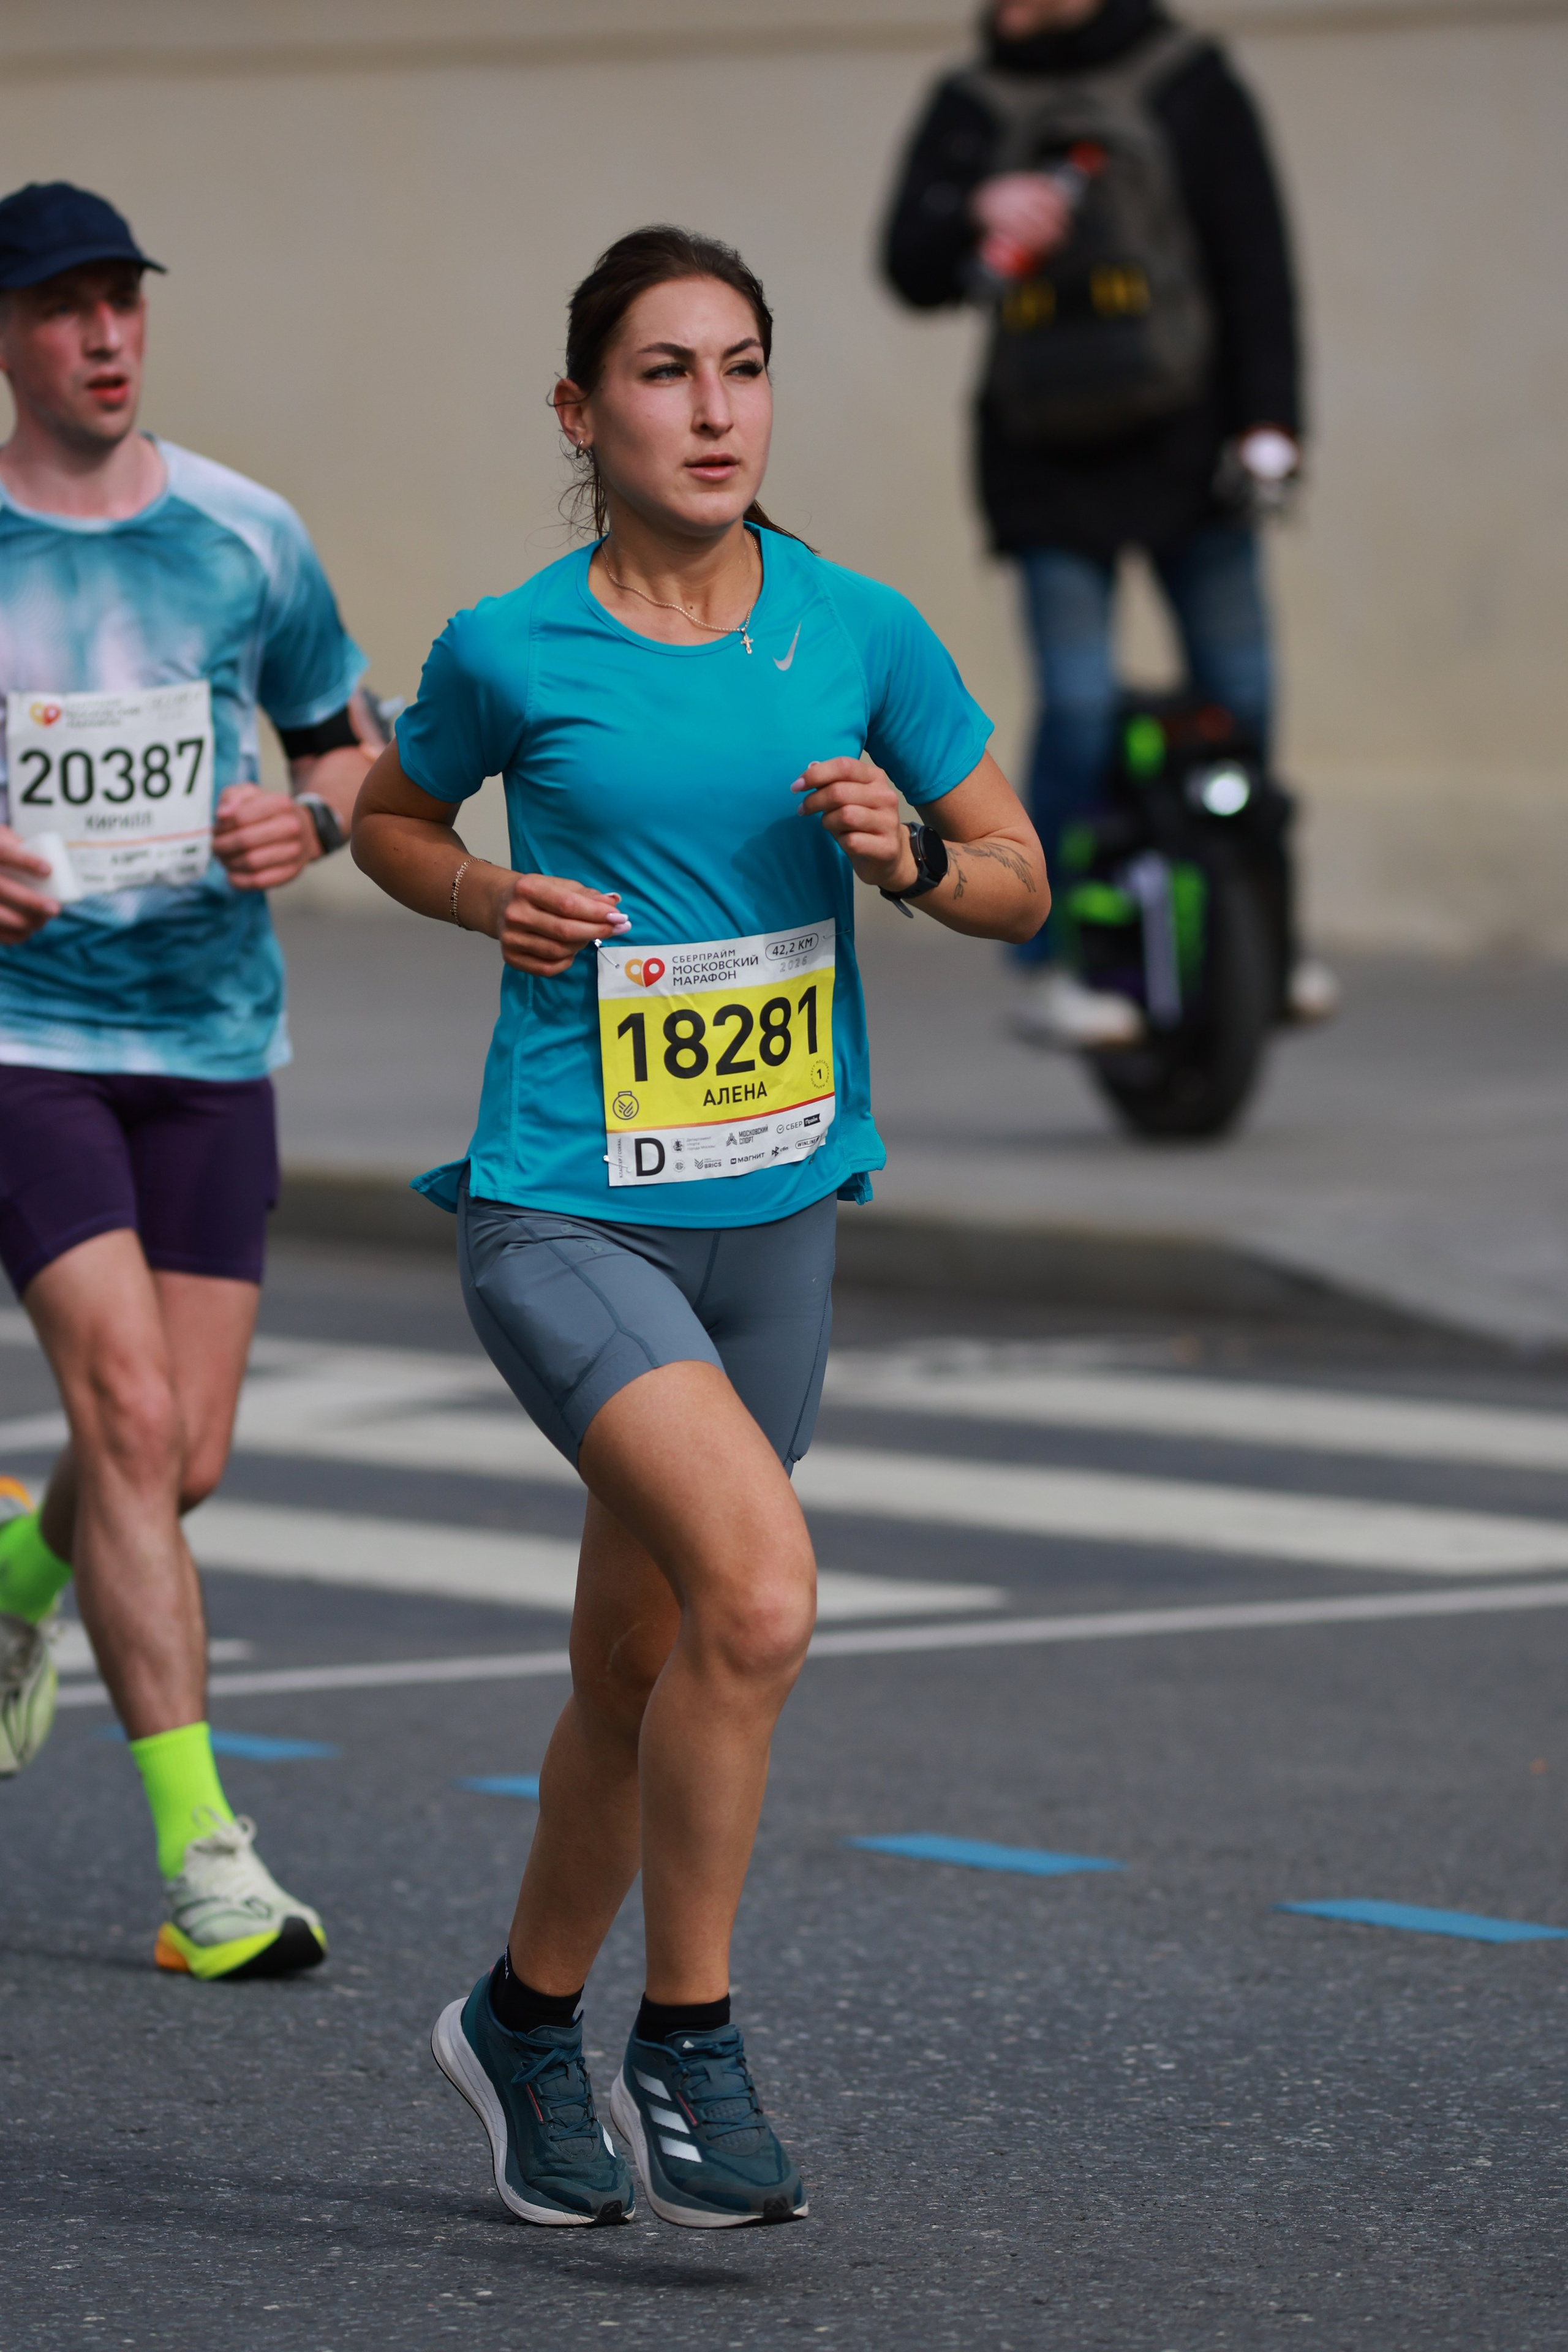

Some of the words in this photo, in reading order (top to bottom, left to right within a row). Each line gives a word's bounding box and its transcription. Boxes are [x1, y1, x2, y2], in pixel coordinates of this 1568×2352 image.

[18, 737, 205, 806] 20387
[772, 943, 795, 956] 42,2
[798, 937, 813, 951] КМ
[672, 949, 736, 963] СБЕРПРАЙМ
[673, 955, 758, 975] МОСКОВСКИЙ
[673, 970, 736, 986] МАРАФОН
[617, 985, 818, 1082] 18281
[816, 1068, 822, 1079] 1
[703, 1081, 767, 1106] АЛЕНА
[739, 1125, 769, 1137] МОСКОВСКИЙ
[786, 1121, 803, 1130] СБЕР
[739, 1136, 753, 1145] СПОРТ
[797, 1138, 816, 1147] WINLINE
[635, 1137, 665, 1177] D
